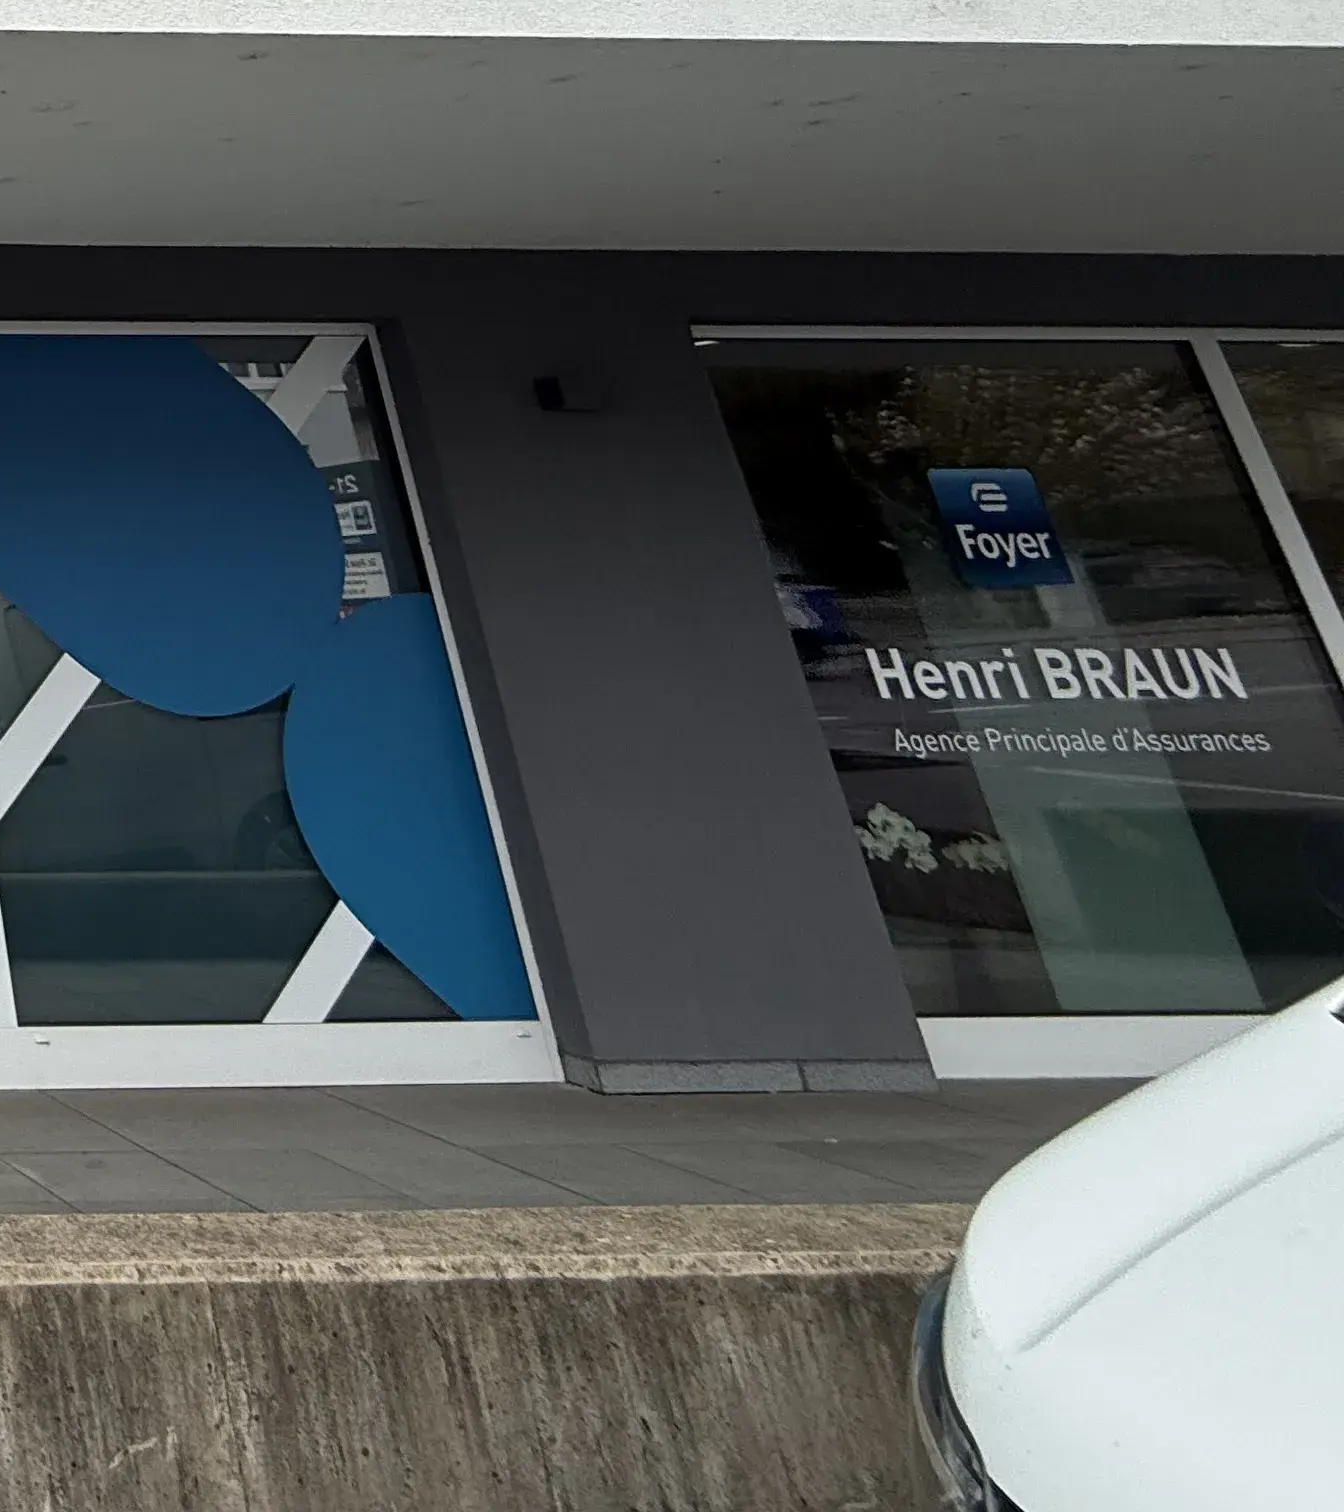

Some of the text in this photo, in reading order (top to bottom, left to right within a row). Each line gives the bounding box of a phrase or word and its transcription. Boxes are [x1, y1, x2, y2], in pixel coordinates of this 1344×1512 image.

[954, 523, 1054, 568] Foyer
[864, 647, 1249, 700] Henri BRAUN
[894, 727, 1272, 760] Agence Principale d'Assurances
